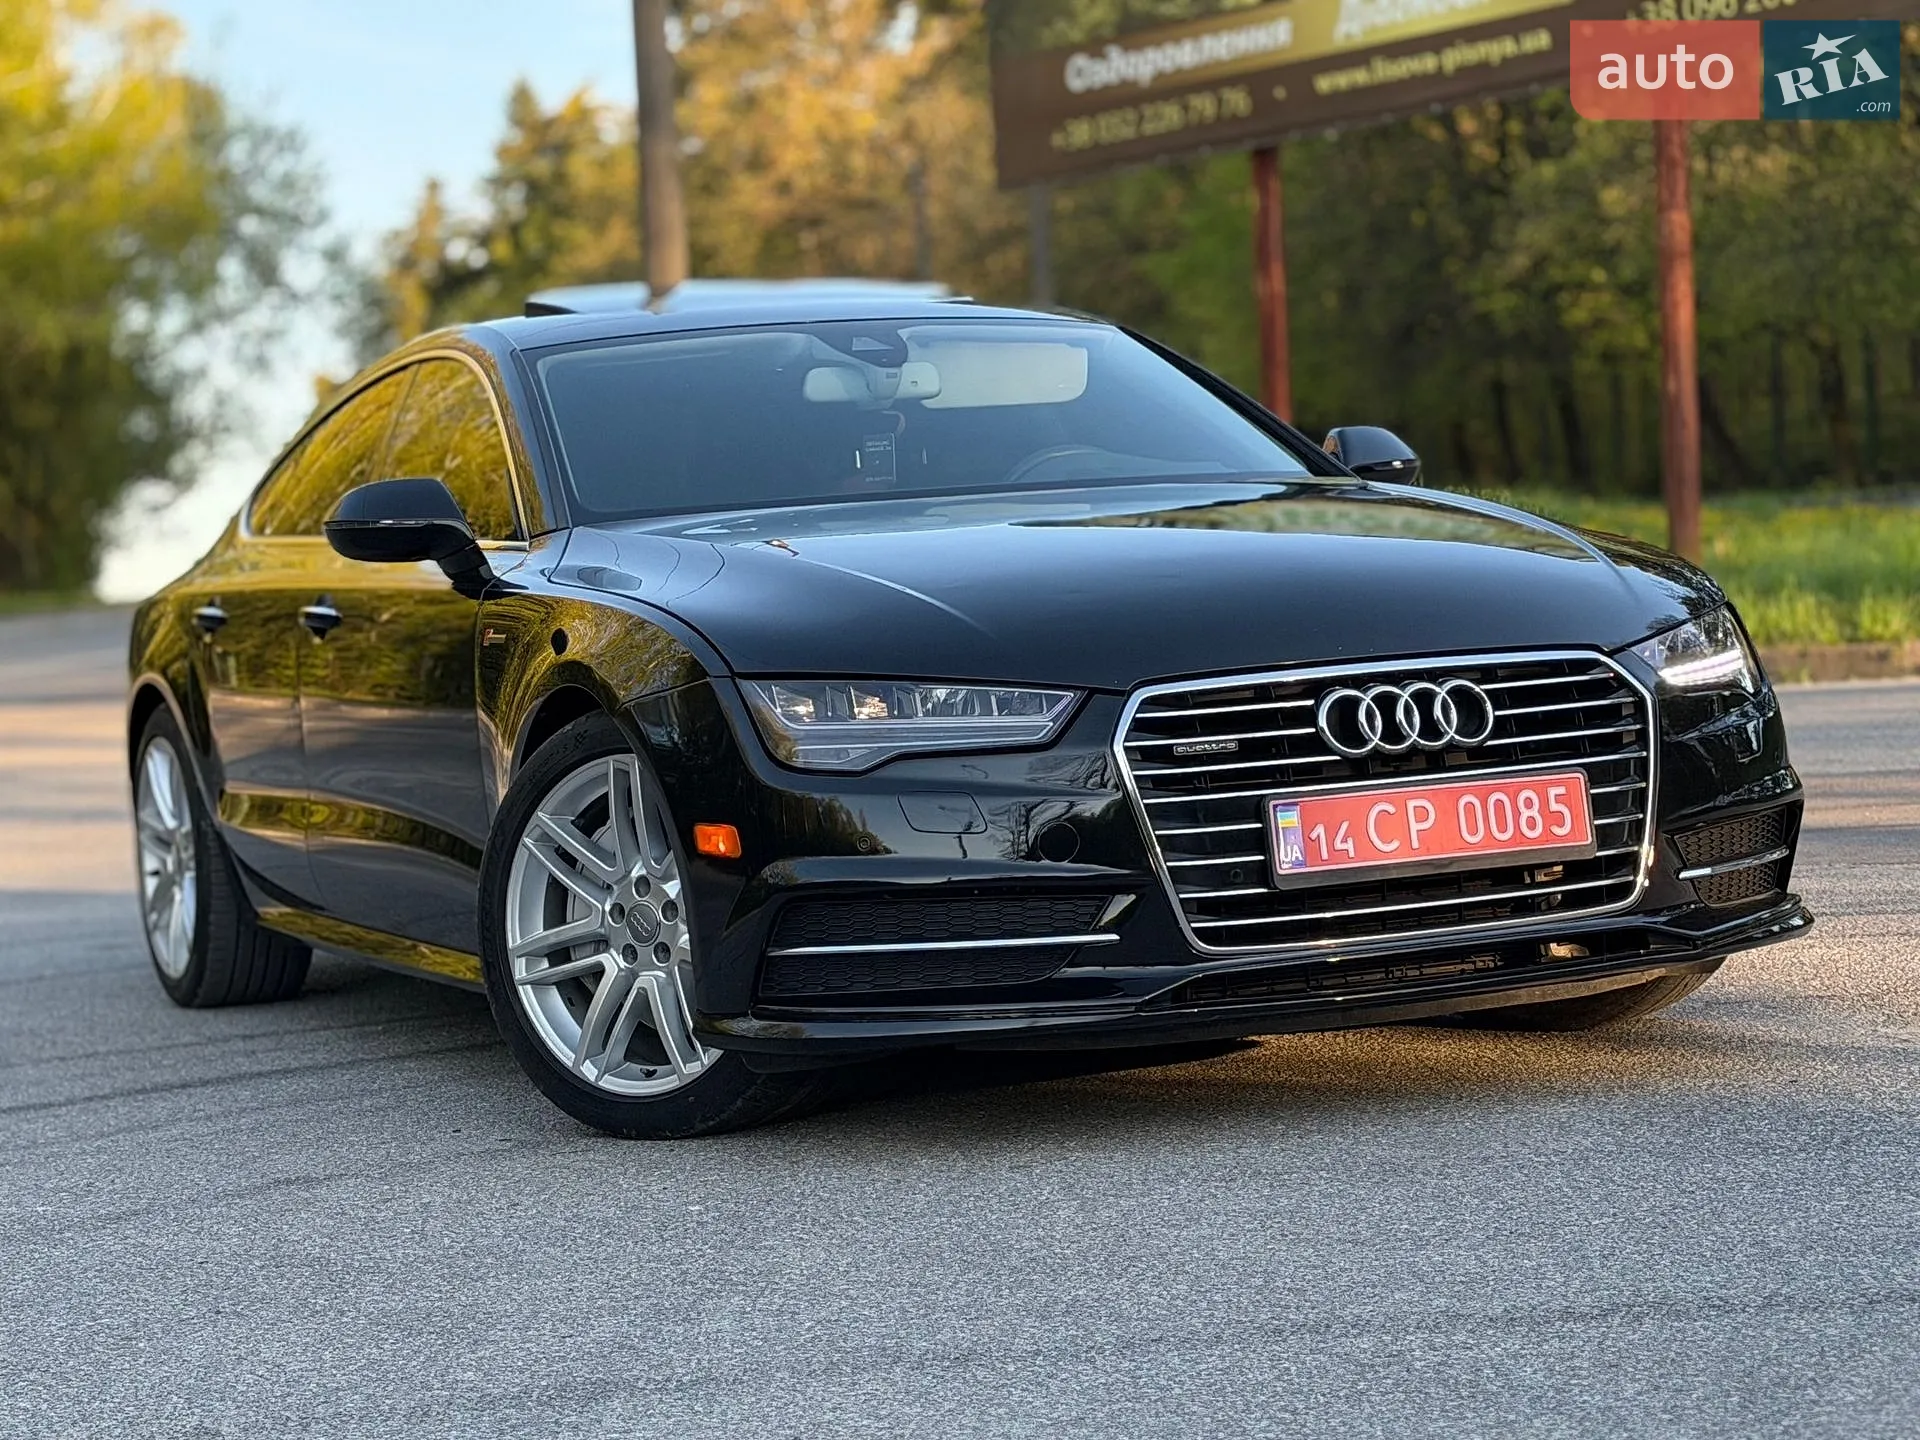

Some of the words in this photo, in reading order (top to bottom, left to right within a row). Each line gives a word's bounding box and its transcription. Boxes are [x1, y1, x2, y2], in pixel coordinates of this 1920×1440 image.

[1176, 742, 1237, 754] quattro
[1308, 820, 1356, 861] 14
[1366, 798, 1437, 854] CP
[1457, 785, 1573, 846] 0085
